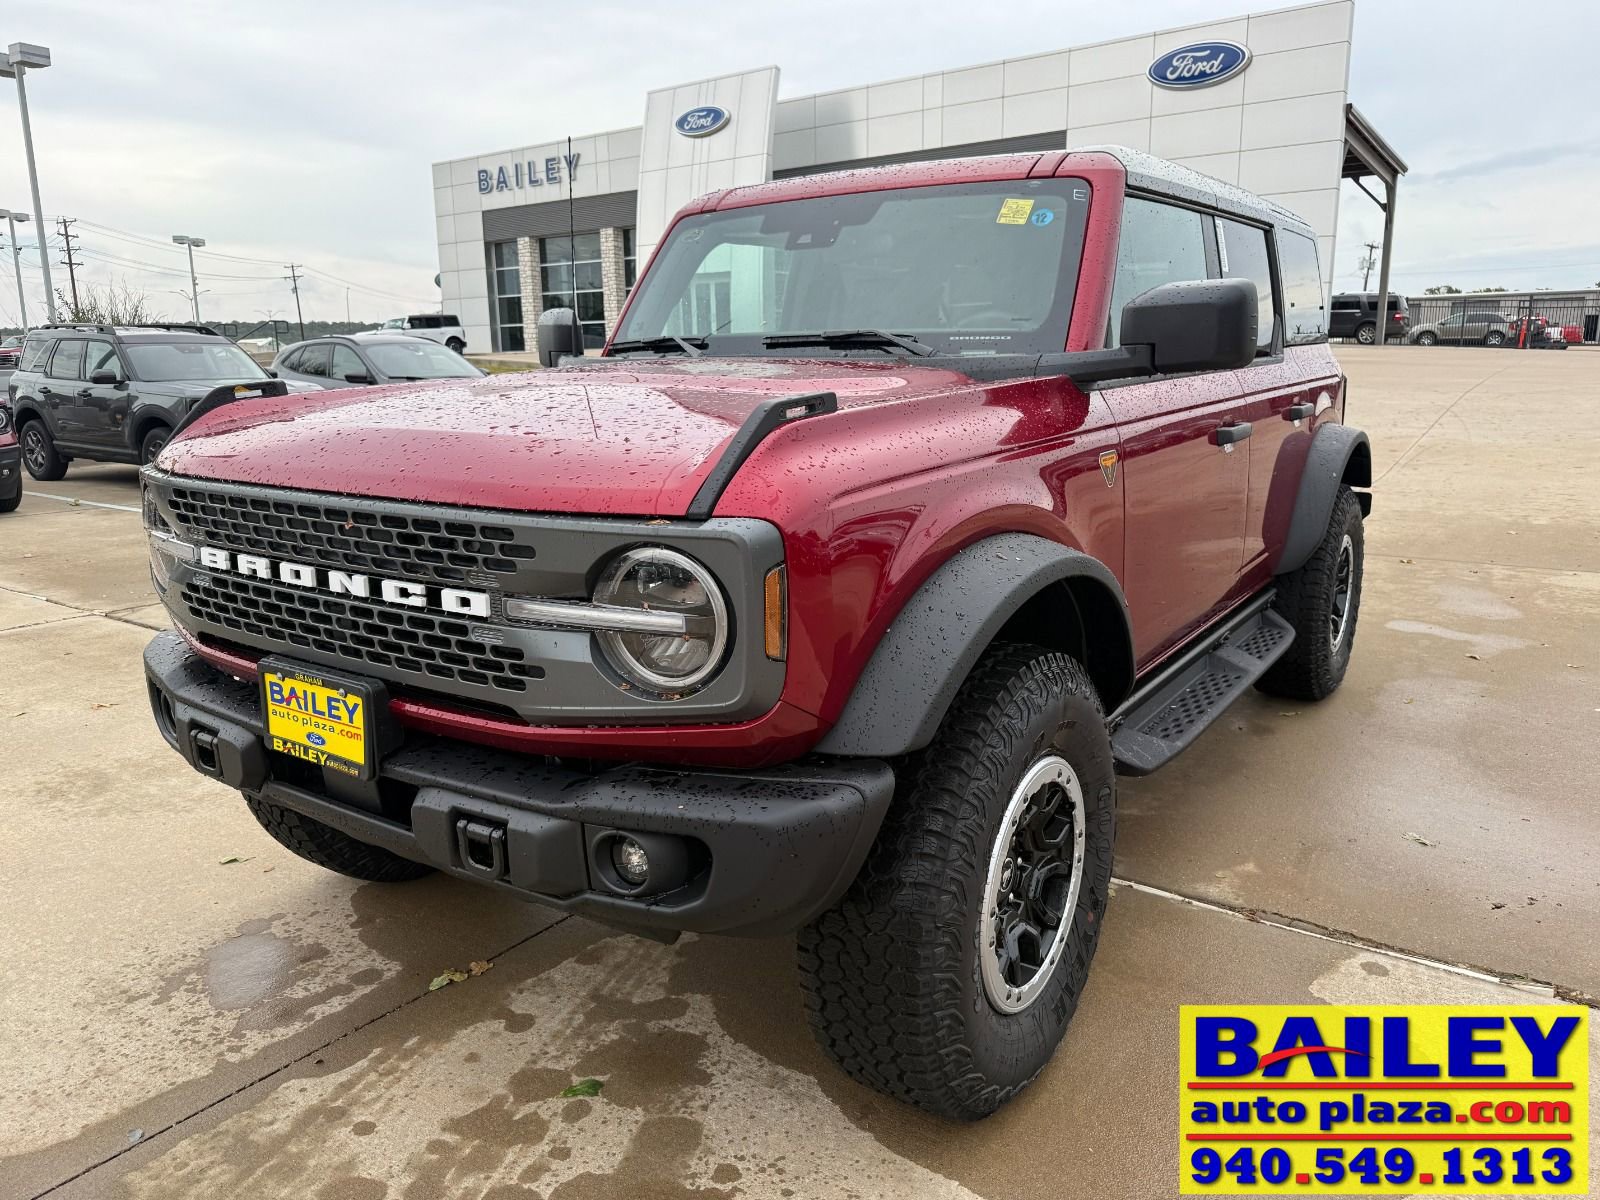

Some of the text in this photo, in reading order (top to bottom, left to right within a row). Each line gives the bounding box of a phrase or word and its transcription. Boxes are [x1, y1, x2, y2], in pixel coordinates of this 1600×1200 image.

[1166, 50, 1225, 81] Ford
[684, 111, 714, 130] Ford
[478, 152, 581, 194] BAILEY
[1073, 189, 1087, 201] E
[201, 546, 491, 618] BRONCO
[294, 673, 324, 687] GRAHAM
[268, 680, 361, 725] BAILEY
[271, 708, 299, 722] auto
[273, 738, 328, 766] BAILEY
